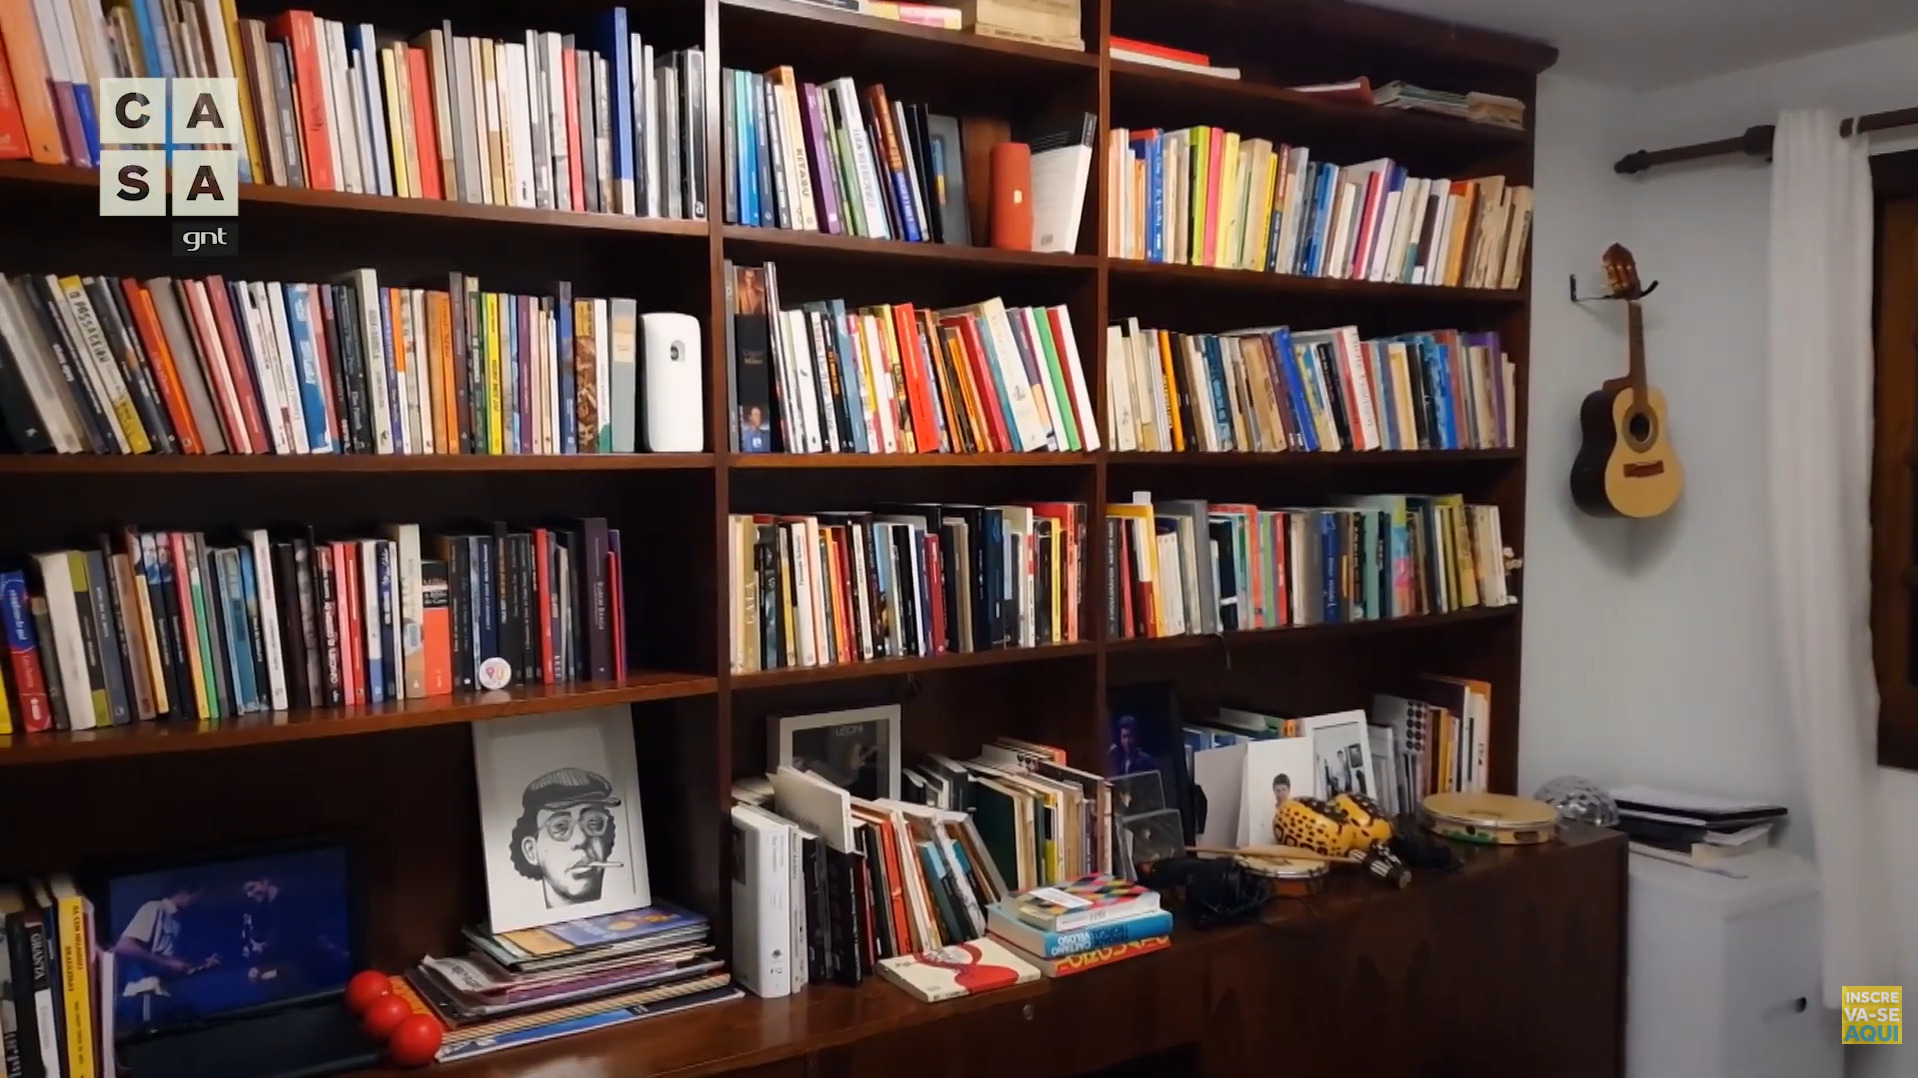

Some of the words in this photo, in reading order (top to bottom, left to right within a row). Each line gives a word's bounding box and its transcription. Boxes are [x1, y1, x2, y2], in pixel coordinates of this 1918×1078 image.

[1057, 931, 1090, 945] VELOSO
[1050, 941, 1092, 955] CAETANO
[31, 934, 45, 978] GRANTA
